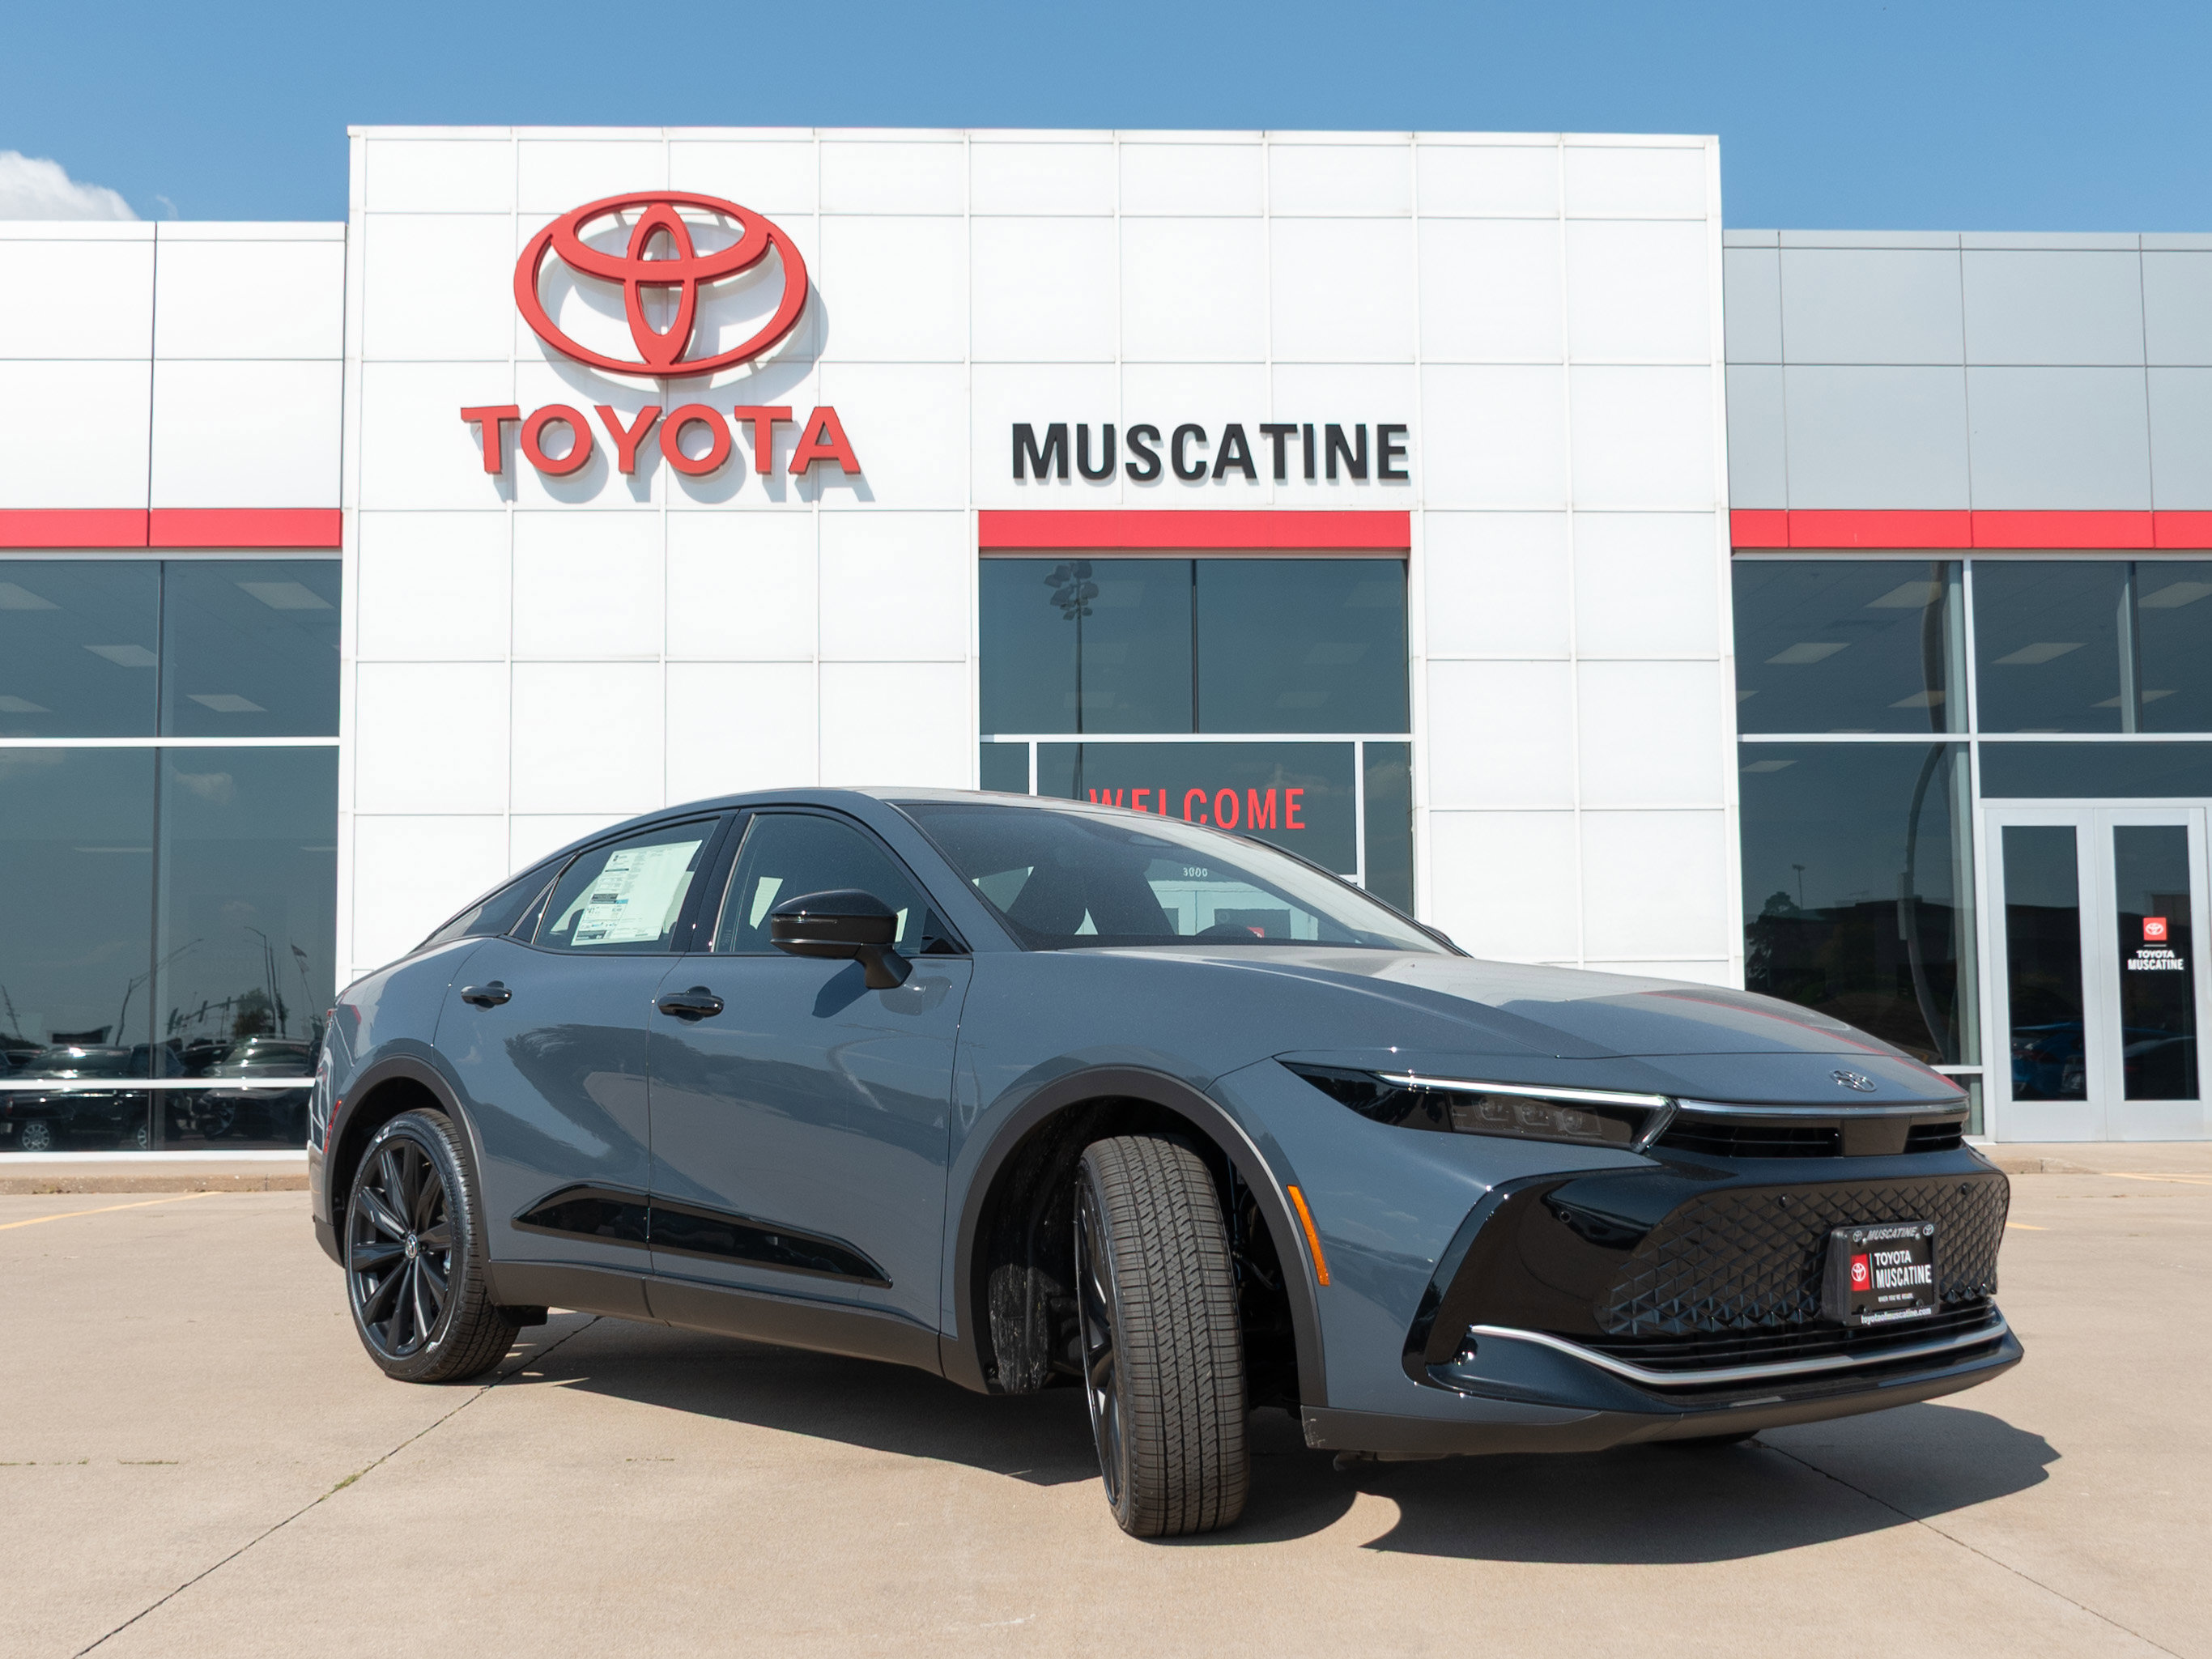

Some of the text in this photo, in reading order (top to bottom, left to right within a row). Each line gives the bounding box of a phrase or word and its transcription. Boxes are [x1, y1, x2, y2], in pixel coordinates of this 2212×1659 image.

[460, 403, 861, 476] TOYOTA
[1012, 423, 1409, 482] MUSCATINE
[2136, 950, 2176, 959] TOYOTA
[2127, 959, 2184, 971] MUSCATINE
[1866, 1226, 1918, 1241] MUSCATINE
[1874, 1250, 1912, 1266] TOYOTA
[1876, 1264, 1933, 1289] MUSCATINE
